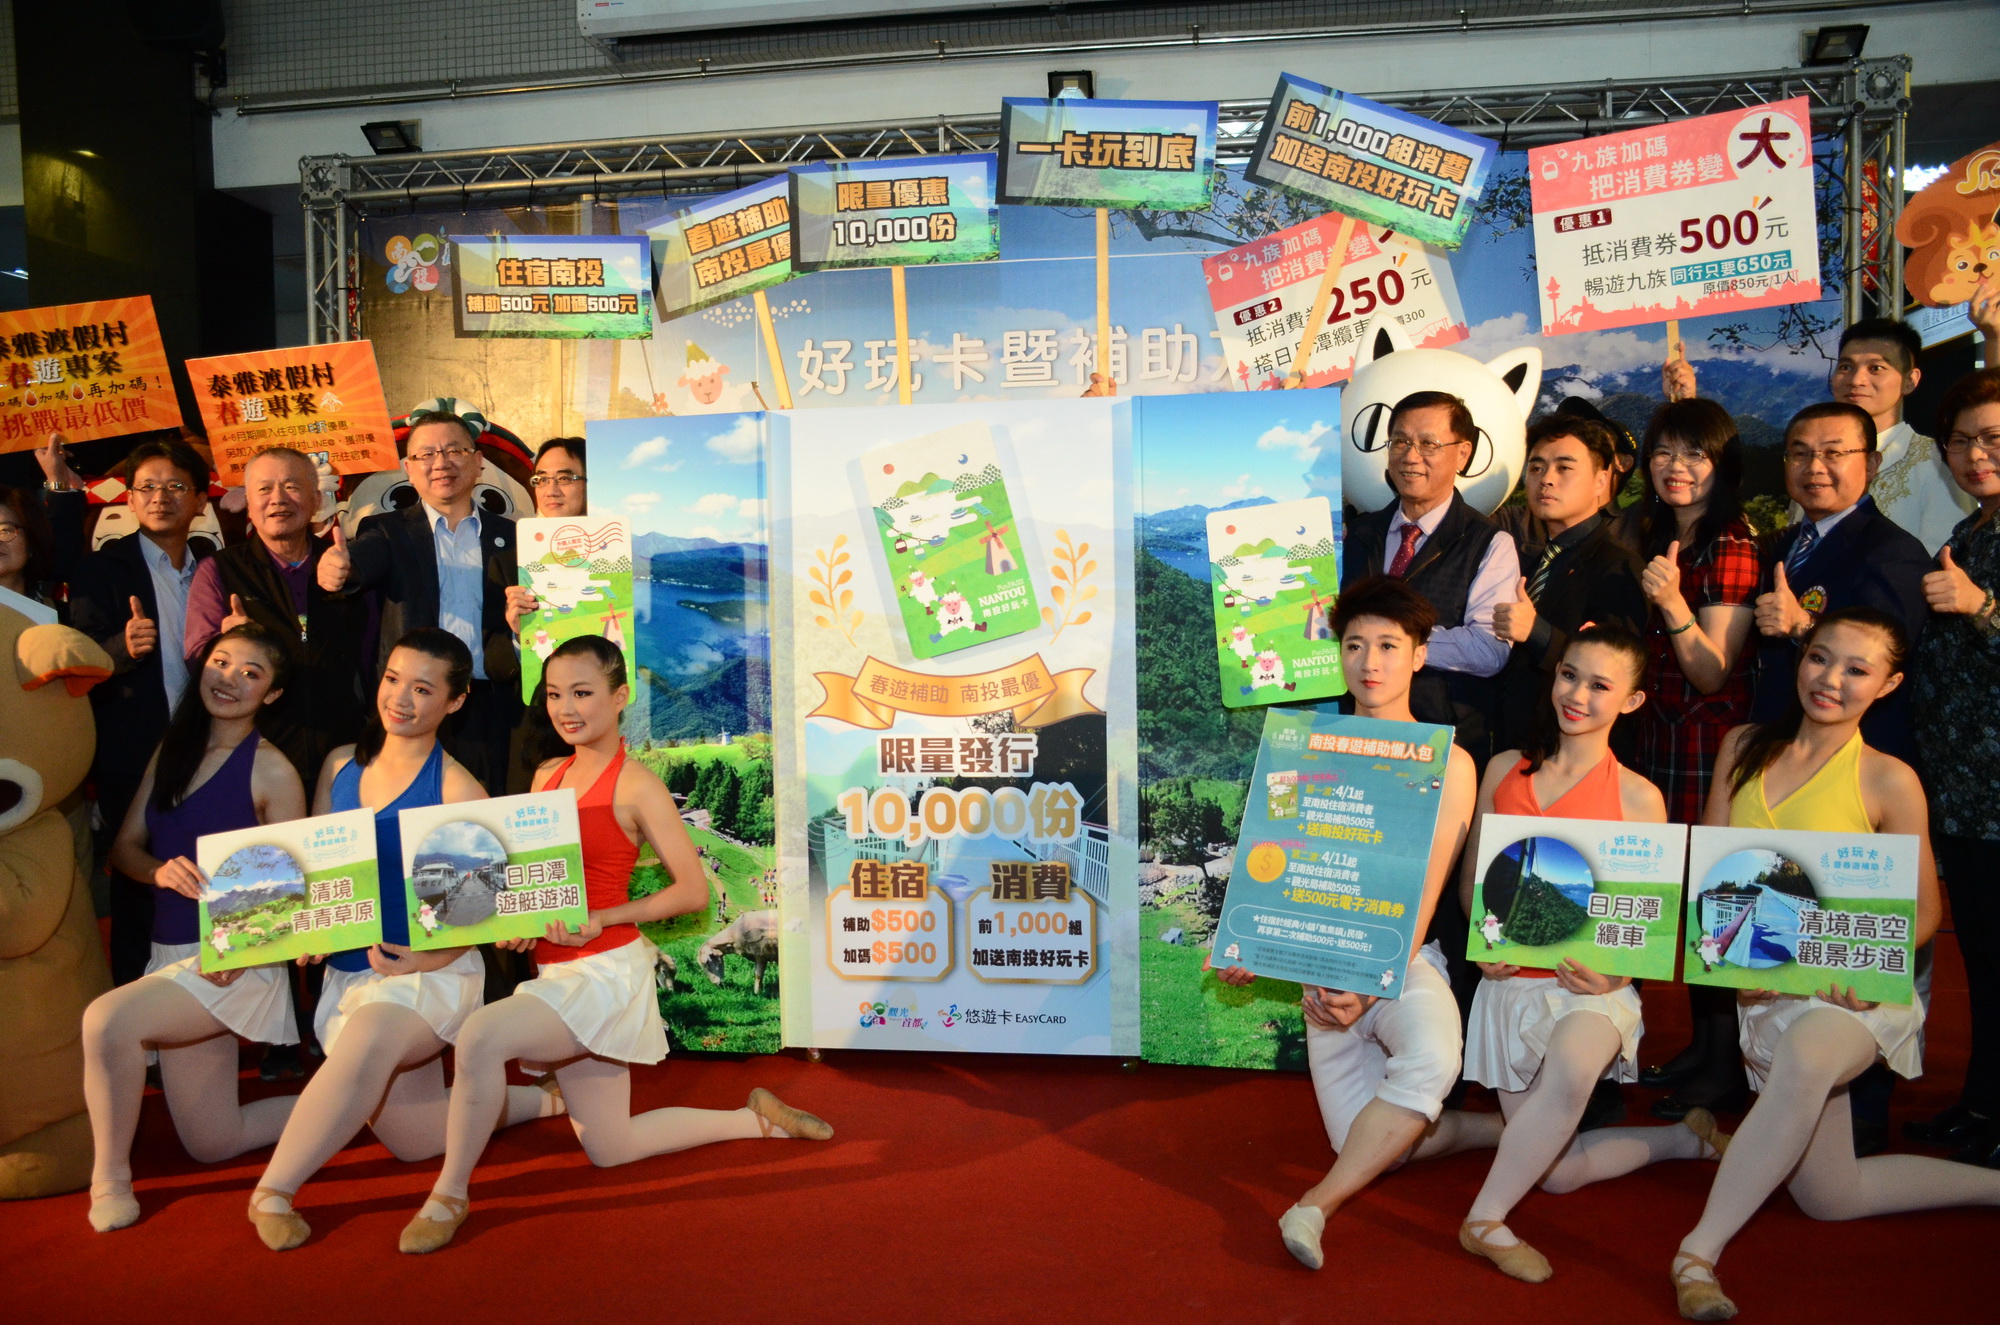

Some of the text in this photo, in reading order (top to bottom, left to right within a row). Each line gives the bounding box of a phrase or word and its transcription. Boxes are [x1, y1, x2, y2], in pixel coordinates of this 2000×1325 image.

[1017, 131, 1197, 171] 一卡玩到底
[1284, 100, 1474, 187] 前1,000組消費
[1571, 135, 1668, 174] 九族加碼
[1736, 117, 1791, 170] 大
[1269, 134, 1461, 220] 加送南投好玩卡
[1589, 154, 1725, 200] 把消費券變
[836, 177, 949, 212] 限量優惠
[684, 195, 790, 255] 春遊補助
[833, 212, 957, 247] 10,000份
[1244, 228, 1322, 270] 九族加碼
[1261, 234, 1372, 290] 把消費變
[497, 258, 605, 287] 住宿南投
[1584, 269, 1668, 298] 暢遊九族
[1672, 251, 1791, 286] 同行只要650元
[1703, 271, 1797, 295] 原價850元/1人
[466, 293, 638, 314] 補助500元 加碼500元
[797, 324, 1230, 397] 好玩卡暨補助
[1254, 318, 1370, 375] 搭日潭纜車
[5, 351, 123, 389] 春遊專案
[207, 362, 335, 398] 泰雅渡假村
[2, 396, 150, 439] 挑戰最低價
[216, 392, 318, 426] 春遊專案
[978, 585, 1026, 607] NANTOU
[1292, 654, 1338, 668] NANTOU
[870, 670, 1042, 704] 春遊補助 南投最優
[880, 735, 1036, 775] 限量發行
[1308, 733, 1434, 762] 南投春遊補助懶人包
[516, 806, 548, 819] 好玩卡
[840, 787, 1079, 841] 10,000份
[1302, 796, 1375, 816] 至南投住宿消費者
[315, 825, 346, 839] 好玩卡
[1614, 835, 1651, 848] 好玩卡
[1837, 846, 1879, 860] 好玩卡
[506, 859, 568, 887] 日月潭
[850, 862, 926, 899] 住宿
[990, 863, 1070, 900] 消費
[1287, 861, 1360, 883] 至南投住宿消費者
[311, 878, 352, 905] 清境
[498, 884, 579, 915] 遊艇遊湖
[292, 900, 375, 933] 青青草原
[843, 908, 936, 934] 補助$500
[978, 910, 1082, 938] 前1,000組
[1588, 896, 1662, 922] 日月潭
[1597, 923, 1645, 947] 纜車
[1798, 911, 1907, 941] 清境高空
[843, 940, 936, 965] 加碼$500
[972, 948, 1089, 968] 加送南投好玩卡
[1797, 941, 1906, 974] 觀景步道
[964, 1009, 1012, 1025] 悠遊卡
